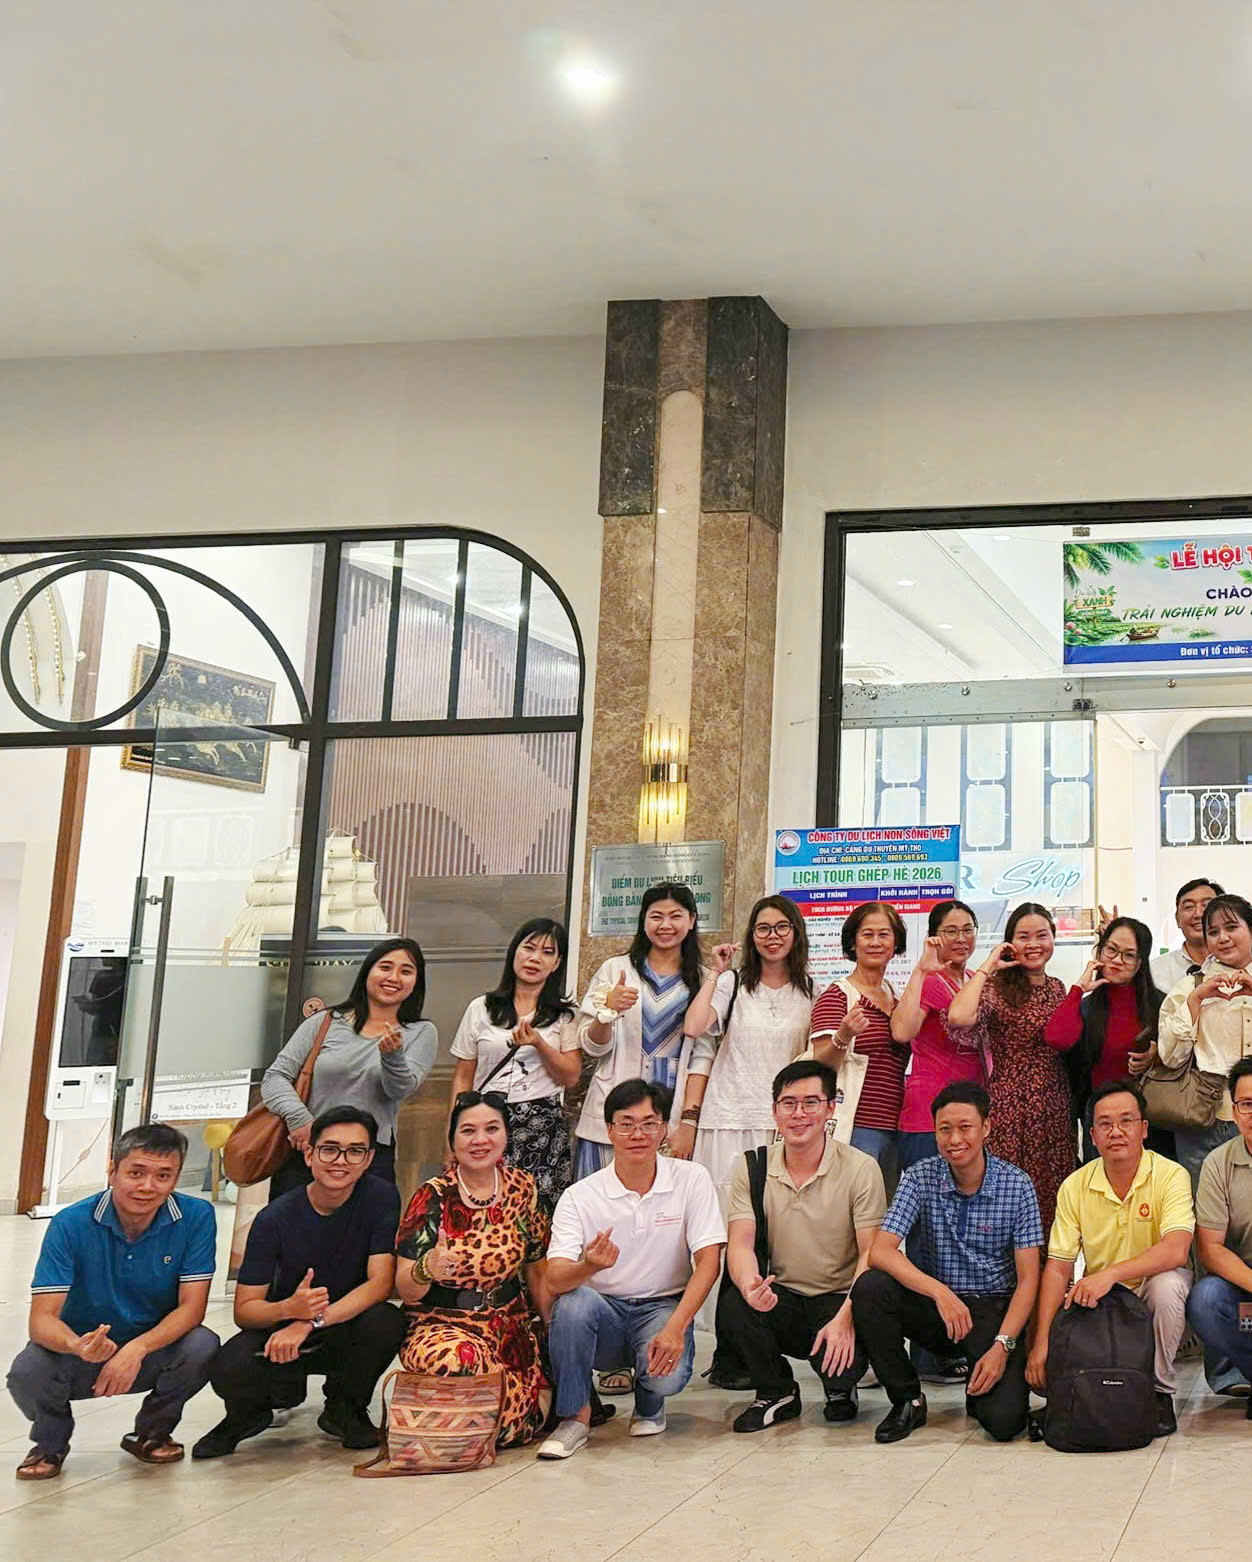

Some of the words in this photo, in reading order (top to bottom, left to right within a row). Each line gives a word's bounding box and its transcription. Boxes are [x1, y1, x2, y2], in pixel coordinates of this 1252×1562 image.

[1171, 541, 1199, 569] LỄ
[1202, 544, 1243, 569] HỘI
[1206, 584, 1252, 600] CHÀO
[1161, 604, 1219, 621] NGHIỆM
[1224, 604, 1246, 617] DU
[1180, 646, 1198, 656] Đơn
[807, 829, 833, 844] CÔNG
[834, 831, 846, 842] TY
[847, 830, 860, 842] DU
[862, 830, 882, 844] LỊCH
[883, 829, 904, 841] NON
[905, 827, 930, 840] SÔNG
[931, 826, 951, 842] VIỆT
[612, 873, 632, 889] ĐIỂM
[792, 870, 819, 888] LỊCH
[823, 869, 854, 883] TOUR
[858, 866, 890, 882] GHÉP
[893, 865, 909, 881] HÈ
[912, 867, 942, 880] 2026
[992, 859, 1081, 898] Shop
